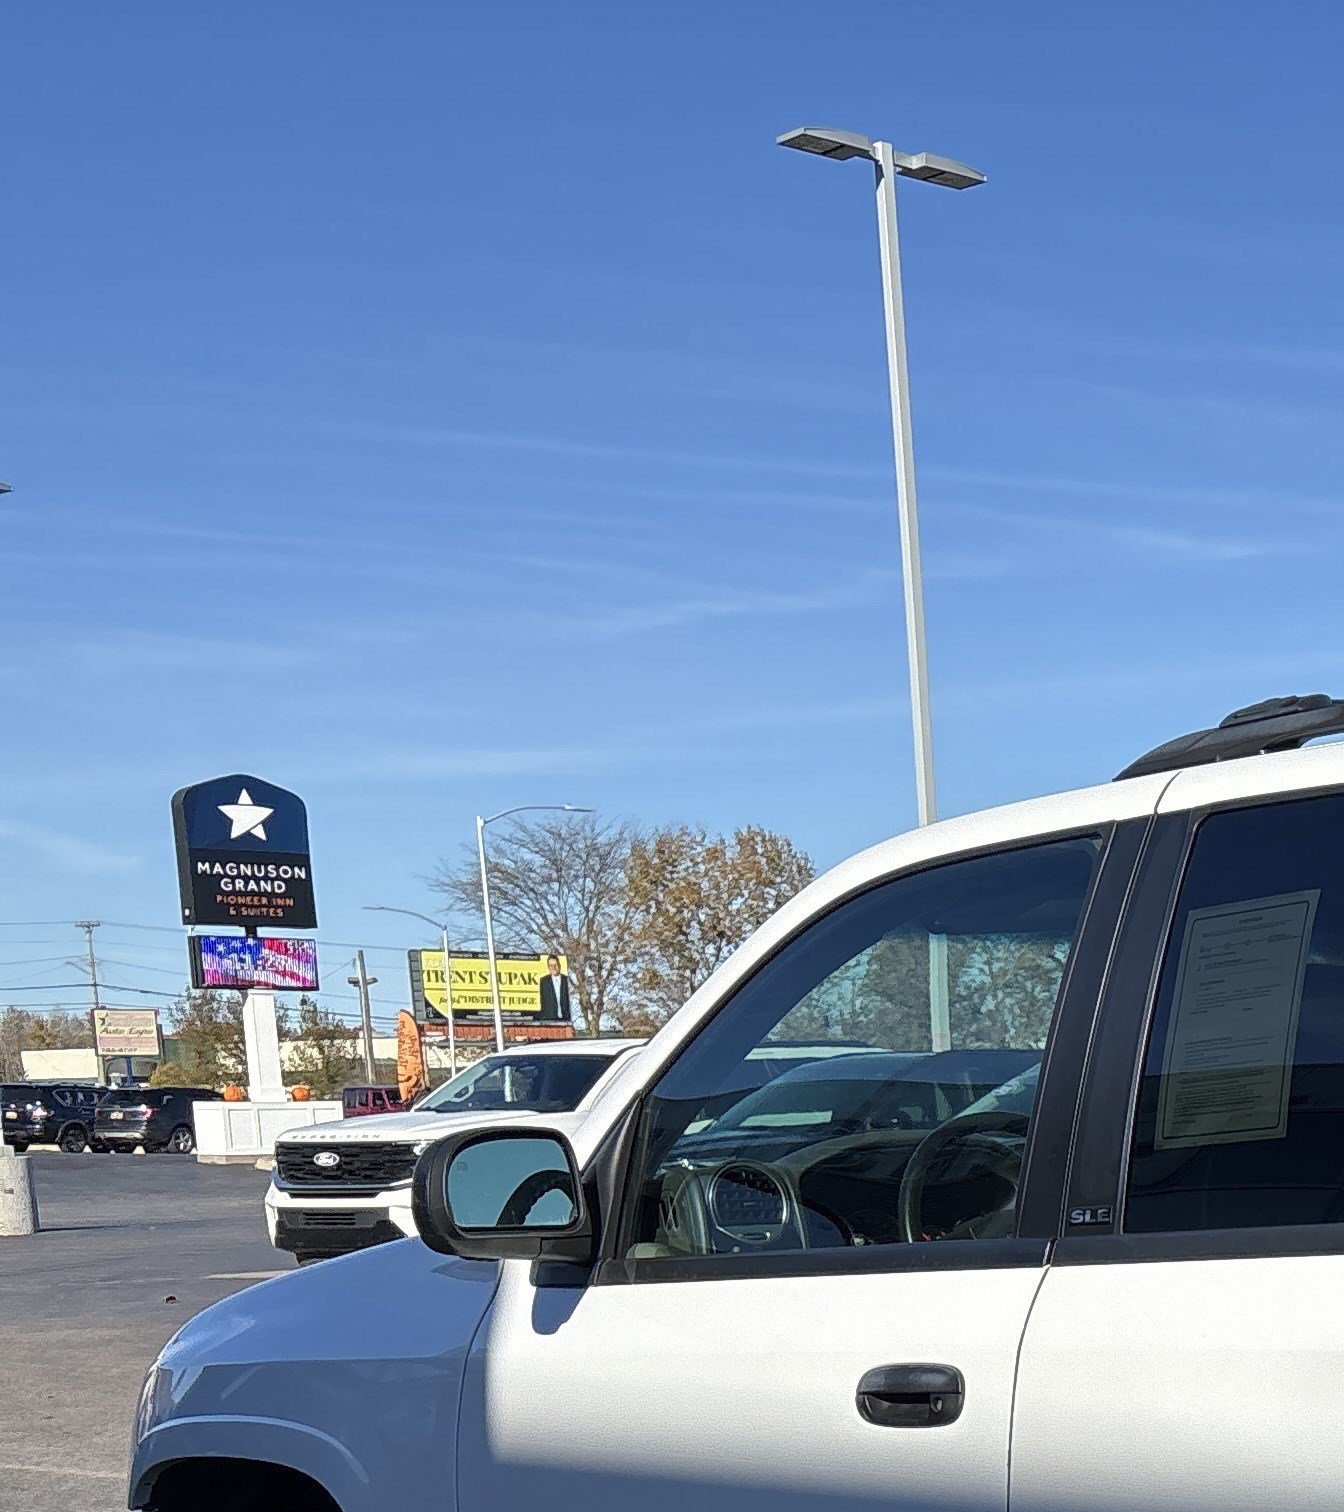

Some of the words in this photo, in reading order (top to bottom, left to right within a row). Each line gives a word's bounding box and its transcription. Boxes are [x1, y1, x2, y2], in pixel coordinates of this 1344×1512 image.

[197, 861, 306, 880] MAGNUSON
[220, 878, 286, 894] GRAND
[216, 894, 268, 906] PIONEER
[272, 898, 294, 907] INN
[229, 906, 237, 916] &
[241, 907, 284, 917] SUITES
[478, 970, 538, 987] SUPAK
[99, 1026, 126, 1036] Auto
[128, 1026, 154, 1038] Expo
[1069, 1207, 1111, 1225] SLE
